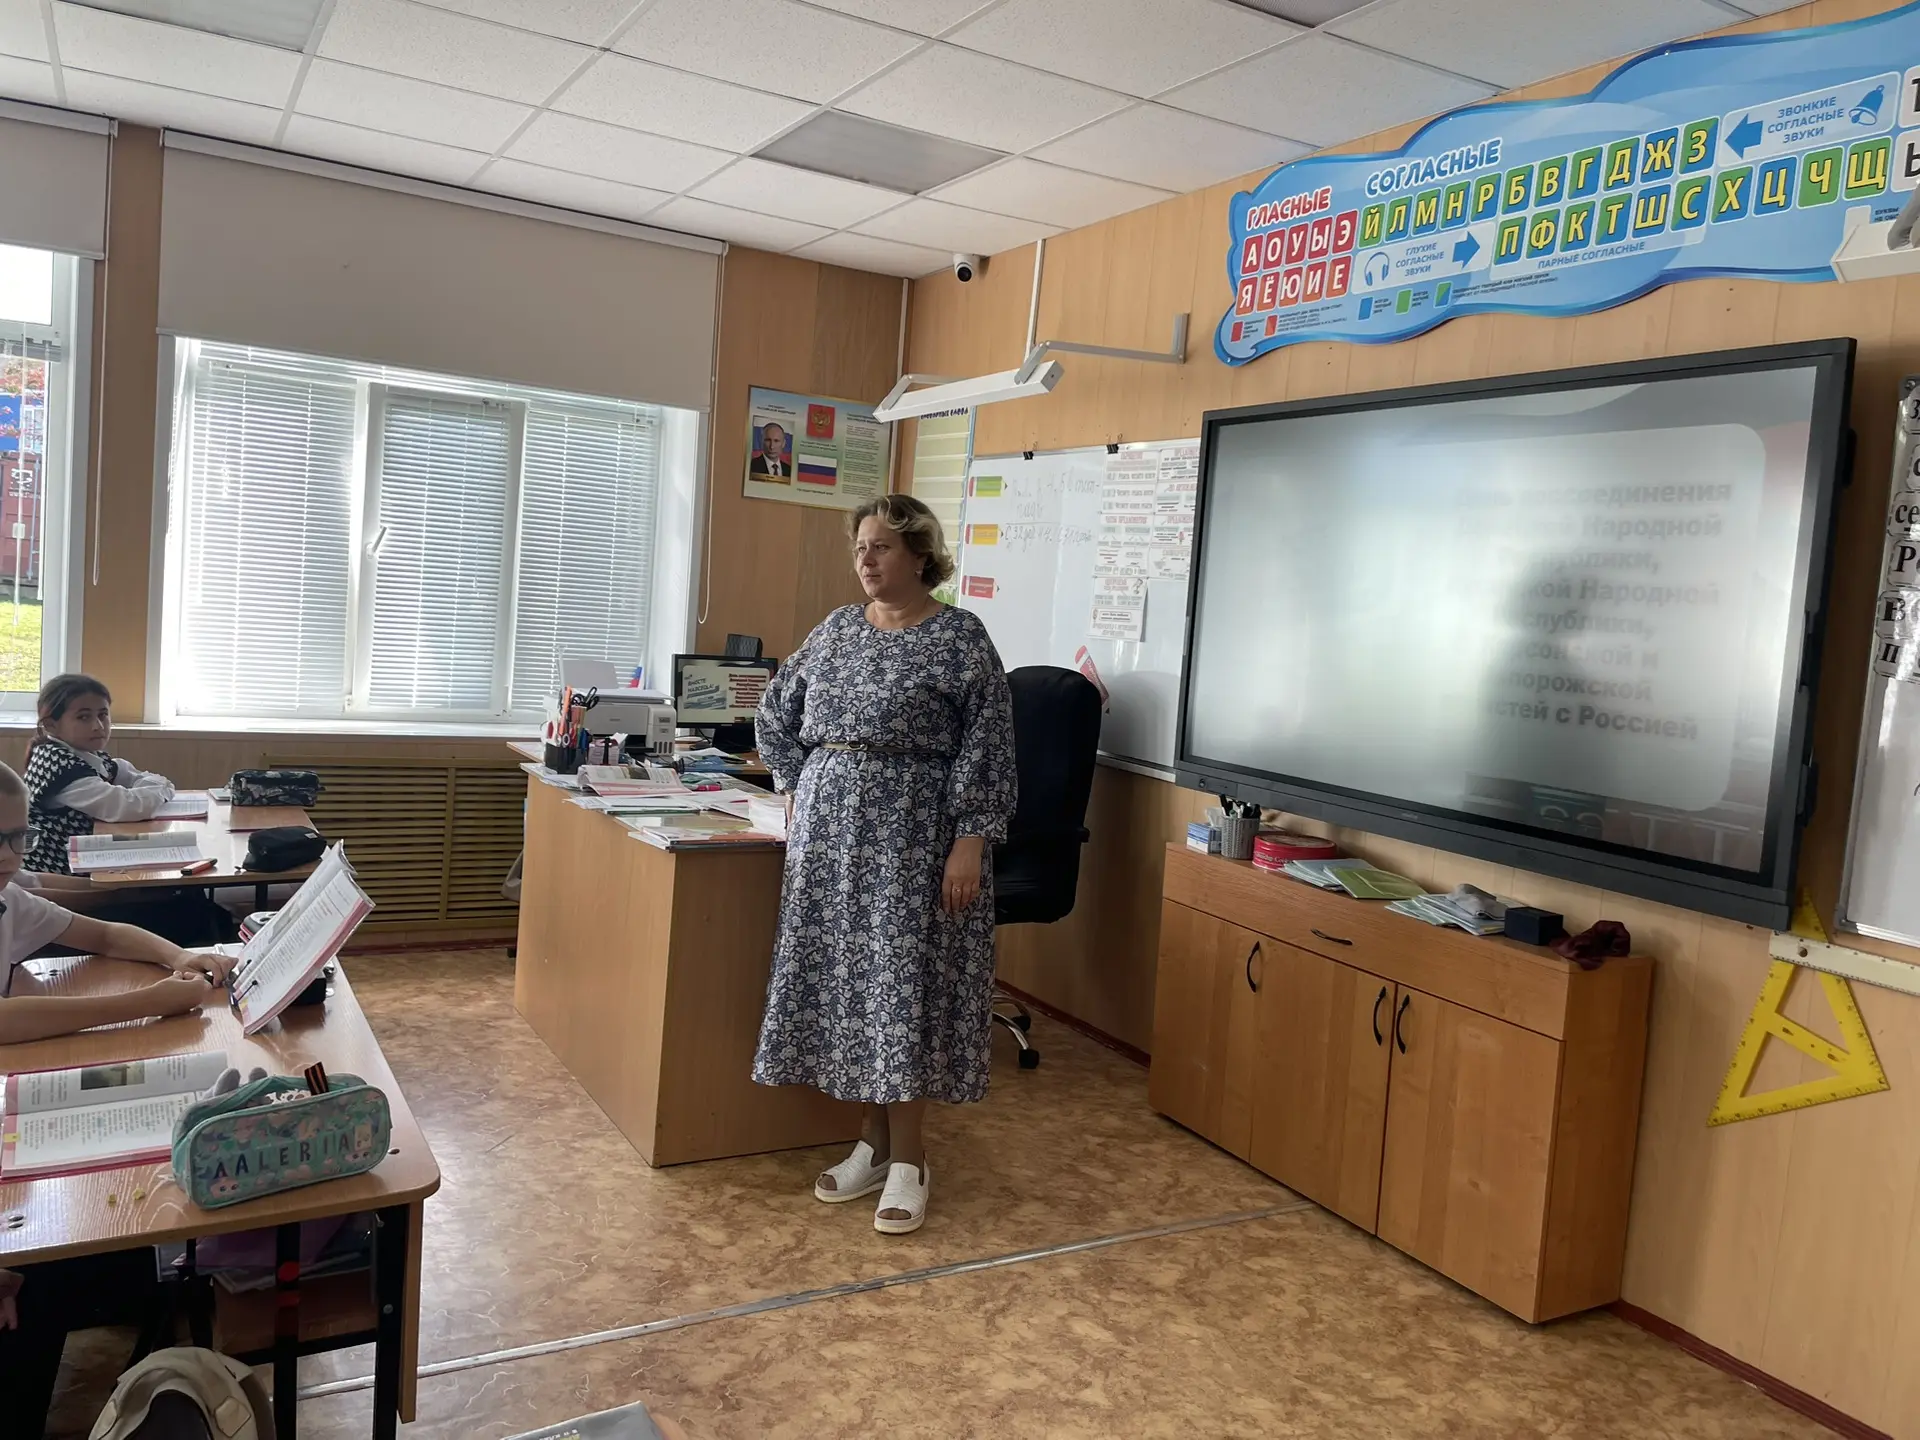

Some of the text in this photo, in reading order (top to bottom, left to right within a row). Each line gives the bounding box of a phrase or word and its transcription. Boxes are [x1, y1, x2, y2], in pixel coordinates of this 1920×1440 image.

[1767, 108, 1845, 134] СОГЛАСНЫЕ
[1777, 96, 1836, 119] ЗВОНКИЕ
[1782, 126, 1824, 144] ЗВУКИ
[1366, 138, 1502, 197] СОГЛАСНЫЕ
[1364, 129, 1708, 240] Й Л М Н Р Б В Г Д Ж З
[1247, 187, 1331, 230] ГЛАСНЫЕ
[1499, 225, 1520, 257] П
[1530, 218, 1555, 251] Ф
[1568, 210, 1588, 242] К
[1606, 202, 1624, 235] Т
[1635, 194, 1668, 230] Ш
[1681, 186, 1702, 220] С
[1719, 176, 1744, 213] Х
[1761, 167, 1787, 207] Ц
[1809, 158, 1832, 194] Ч
[1846, 147, 1887, 190] Щ
[1245, 220, 1351, 267] А О У Ы Э
[1395, 250, 1444, 268] СОГЛАСНЫЕ
[1405, 242, 1437, 256] ГЛУХИЕ
[1537, 241, 1645, 270] ПАРНЫЕ СОГЛАСНЫЕ
[1240, 264, 1345, 308] Я Ё Ю И Е
[1404, 263, 1431, 278] ЗВУКИ
[1579, 578, 1720, 607] Народной
[1522, 609, 1656, 641] спублики,
[1504, 669, 1653, 701] порожской
[1555, 706, 1572, 725] с
[1578, 704, 1698, 740] Россией
